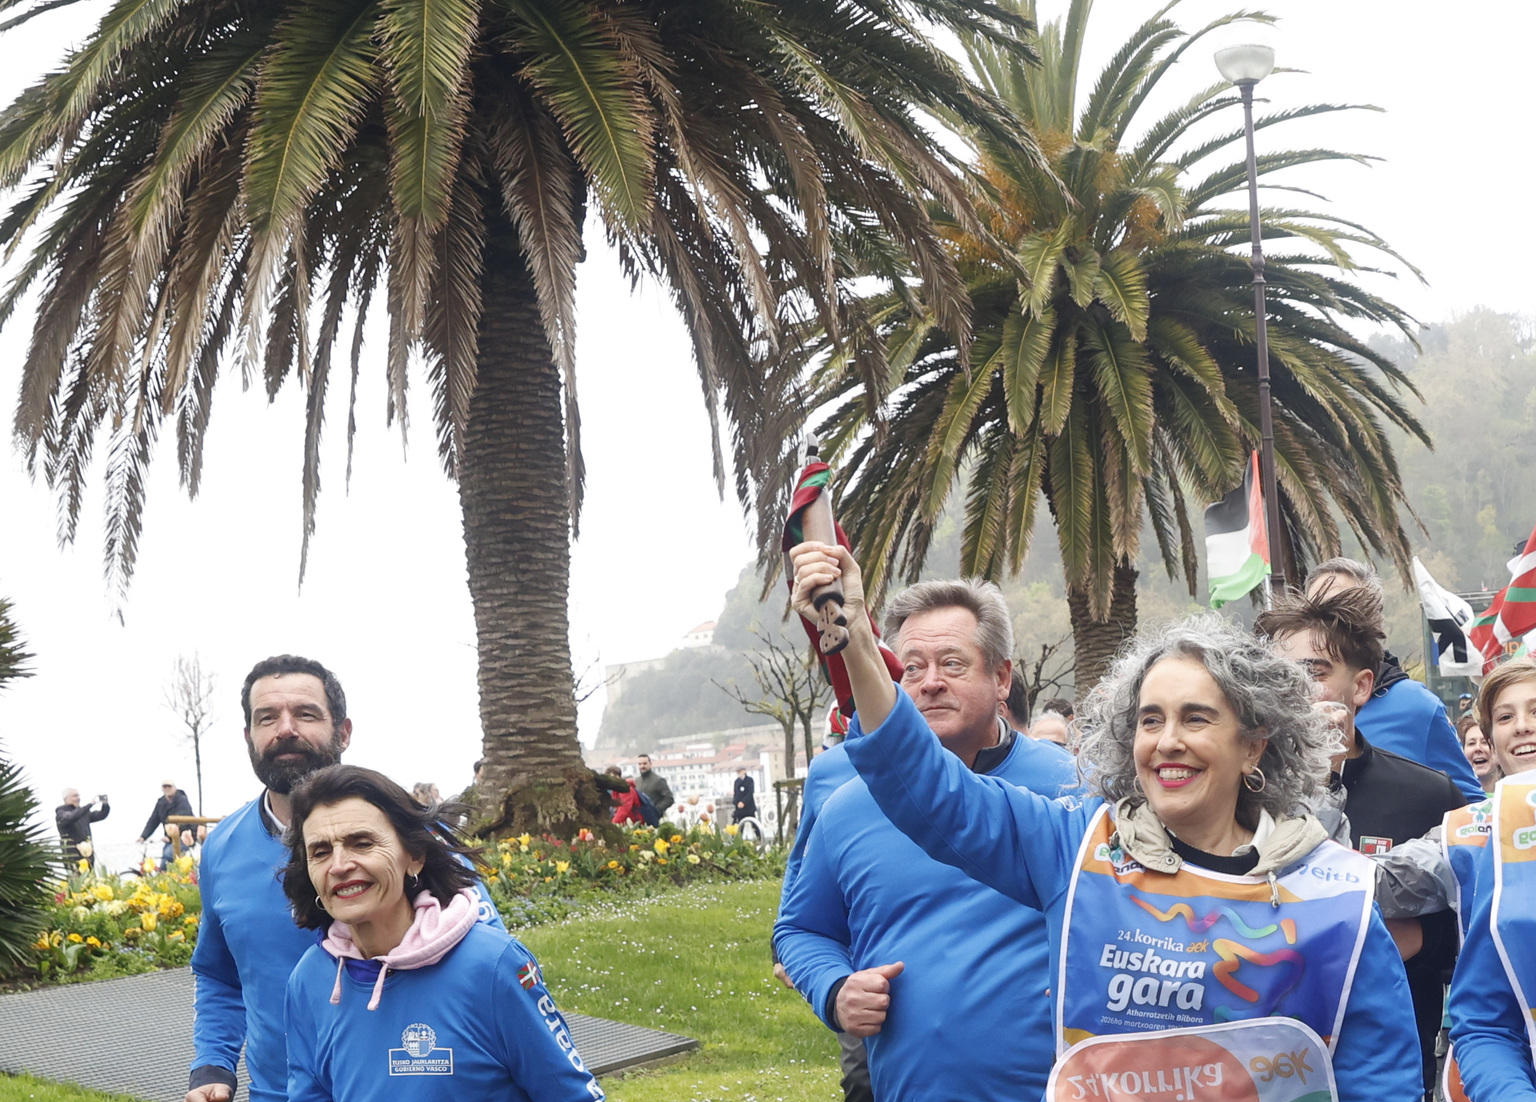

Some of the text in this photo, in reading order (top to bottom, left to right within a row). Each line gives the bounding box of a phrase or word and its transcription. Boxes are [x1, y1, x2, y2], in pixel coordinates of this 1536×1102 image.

[1311, 866, 1360, 884] eitb
[1117, 928, 1210, 953] 24.korrika aek
[1099, 943, 1207, 980] Euskara
[1106, 973, 1205, 1012] gara
[1123, 1018, 1166, 1031] martxoaren
[1126, 1008, 1204, 1024] Atharratzetik Bilbora
